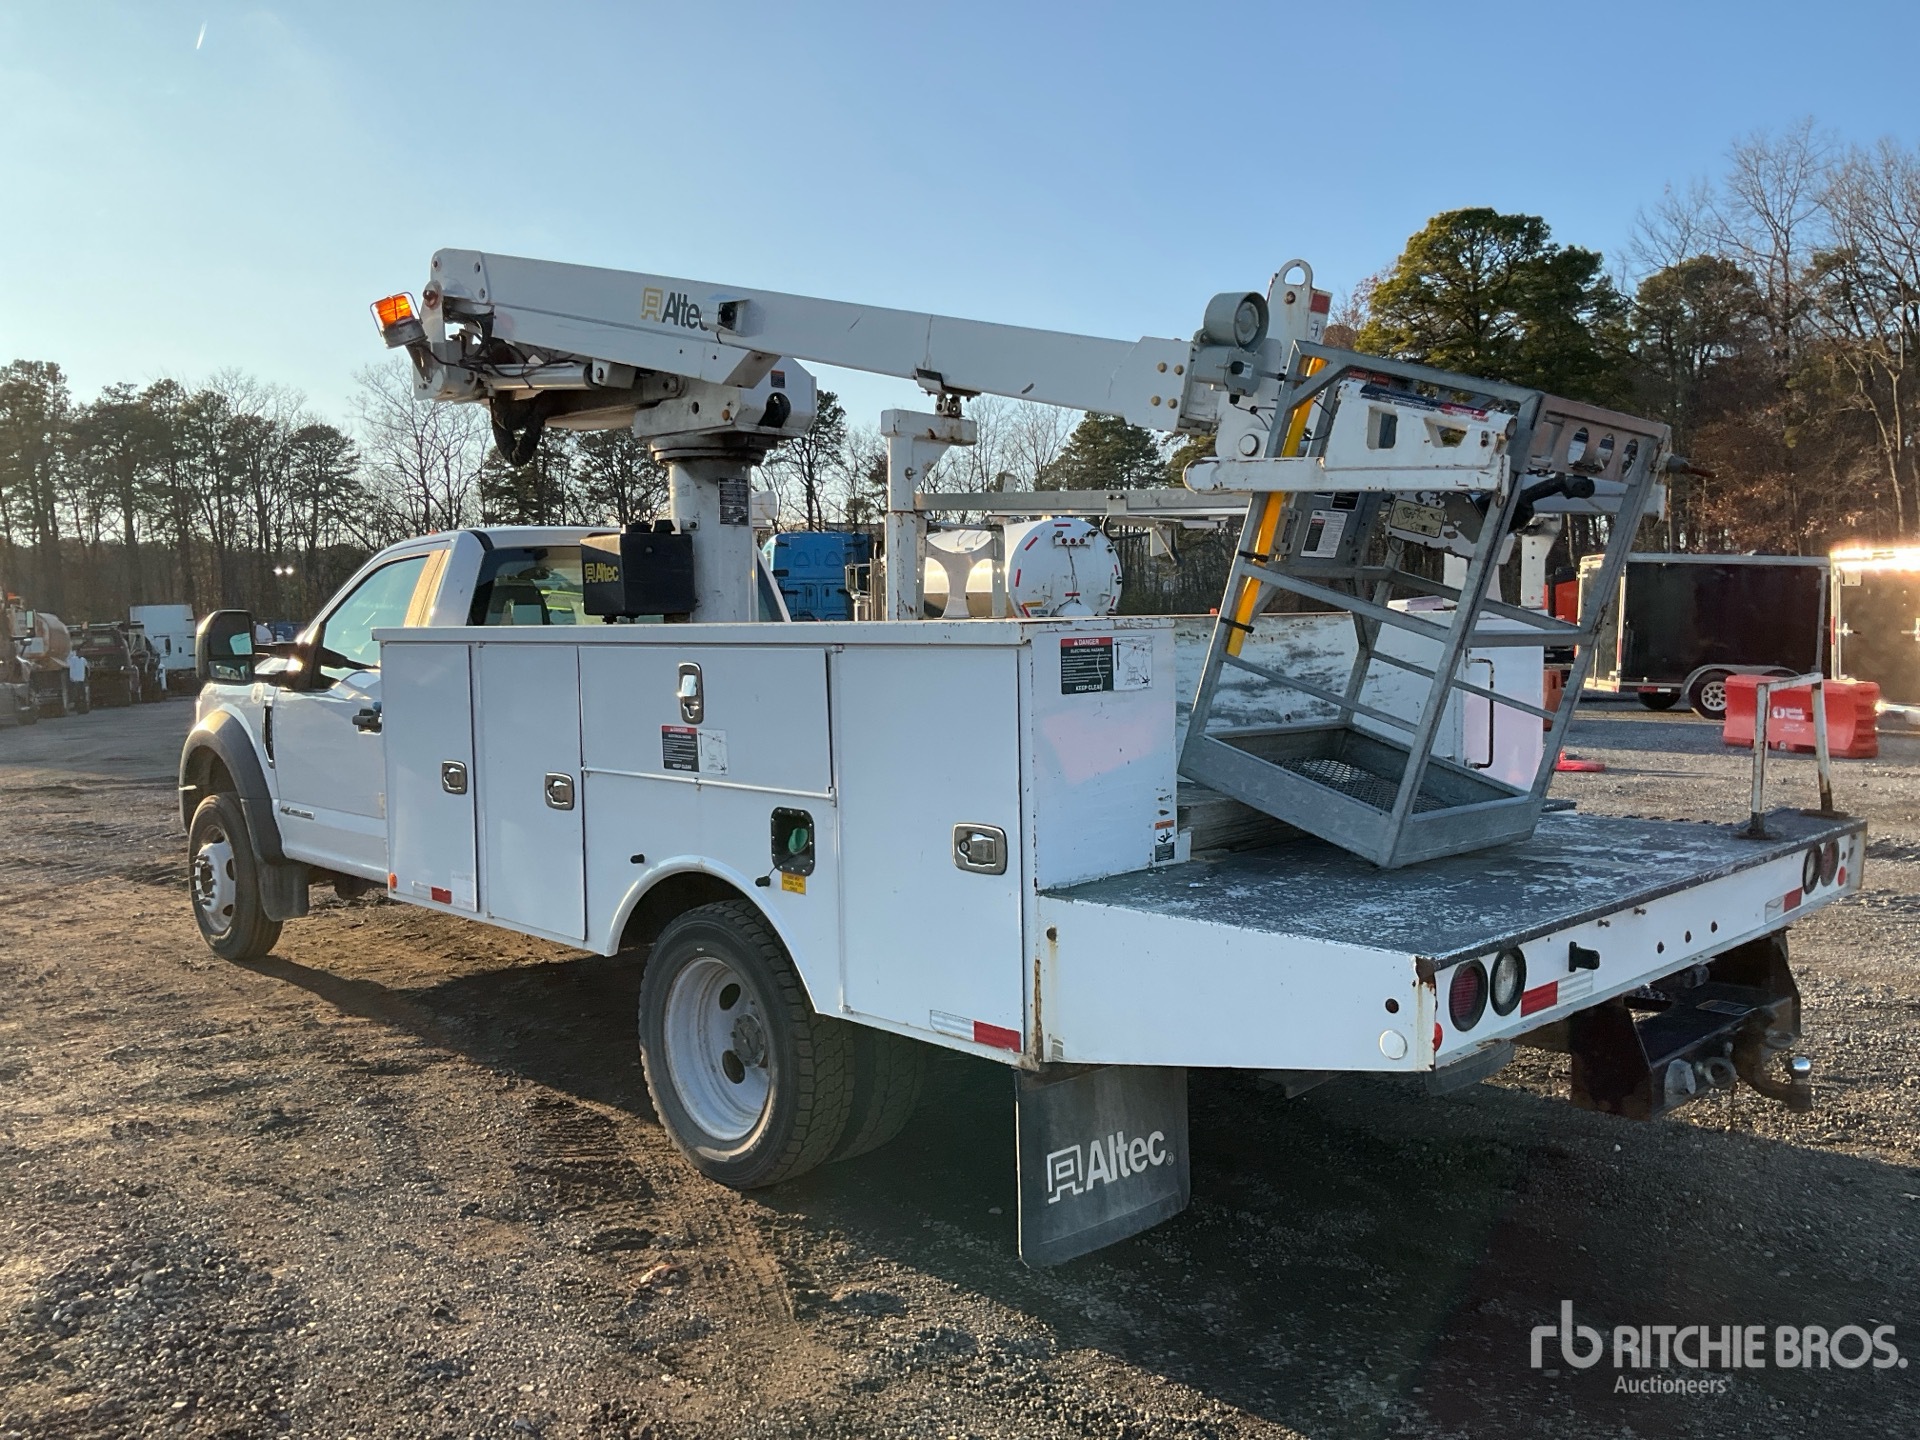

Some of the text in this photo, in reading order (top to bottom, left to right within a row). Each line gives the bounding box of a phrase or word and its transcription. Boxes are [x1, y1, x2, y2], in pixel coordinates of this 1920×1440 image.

[596, 563, 619, 583] Altec
[1078, 638, 1100, 646] DANGER
[1086, 1131, 1166, 1191] Altec
